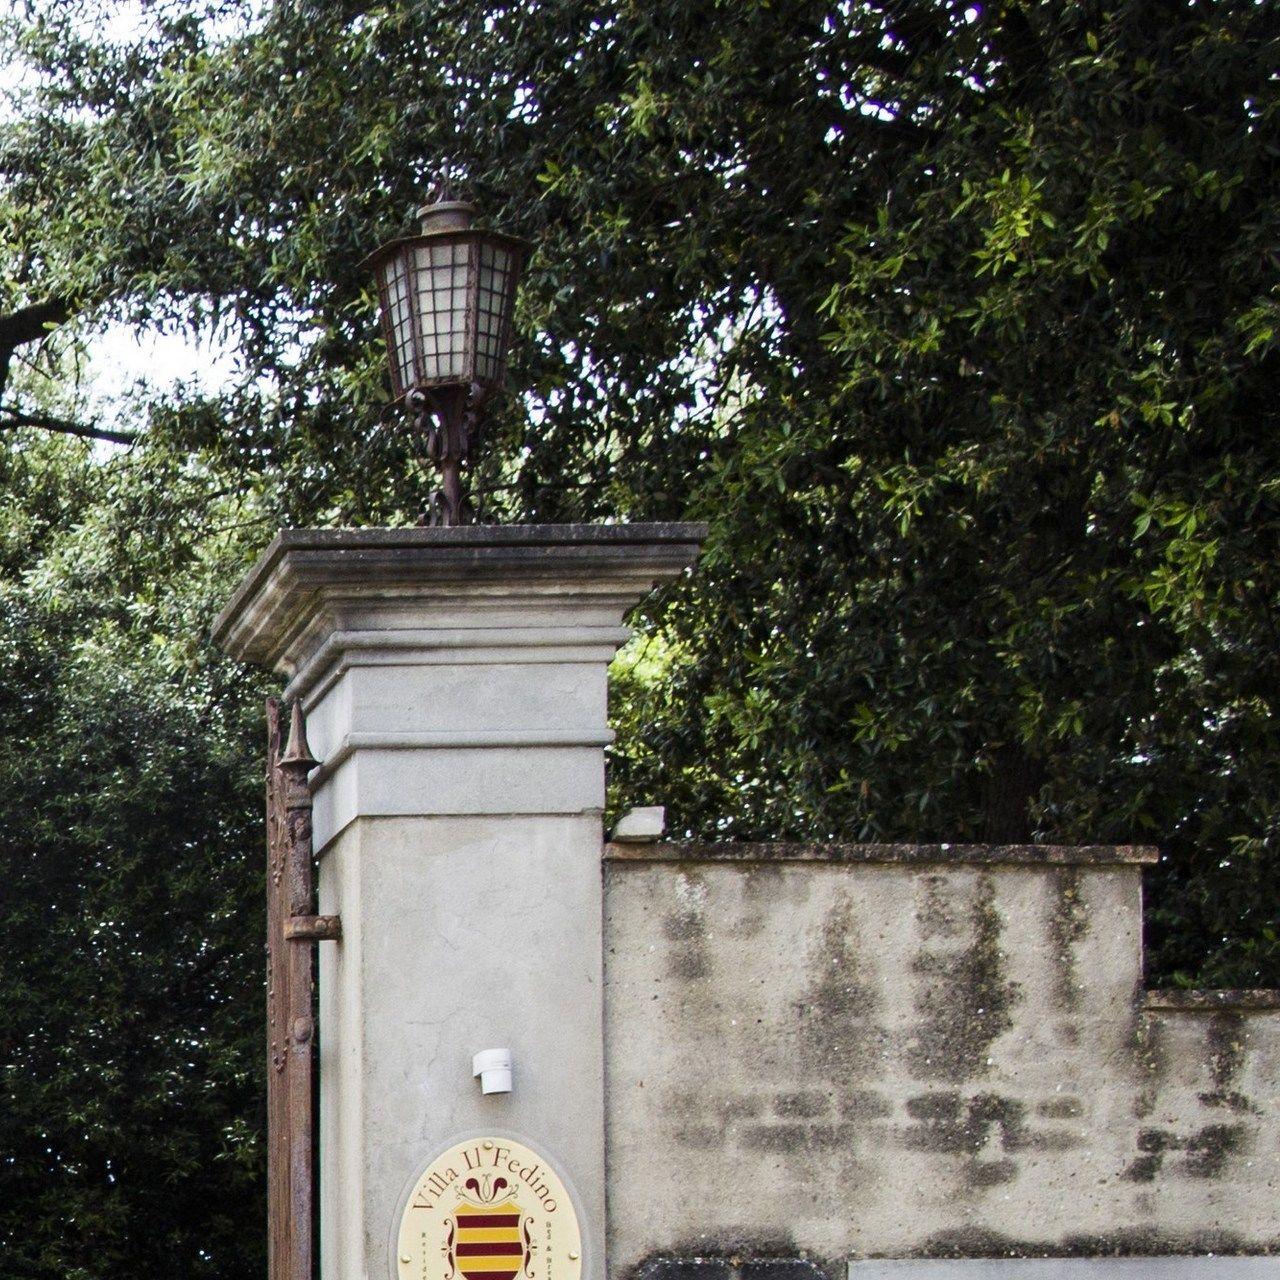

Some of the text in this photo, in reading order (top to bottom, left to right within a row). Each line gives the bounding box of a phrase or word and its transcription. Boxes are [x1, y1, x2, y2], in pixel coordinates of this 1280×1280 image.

[412, 1146, 558, 1213] Villa Il Fedino
